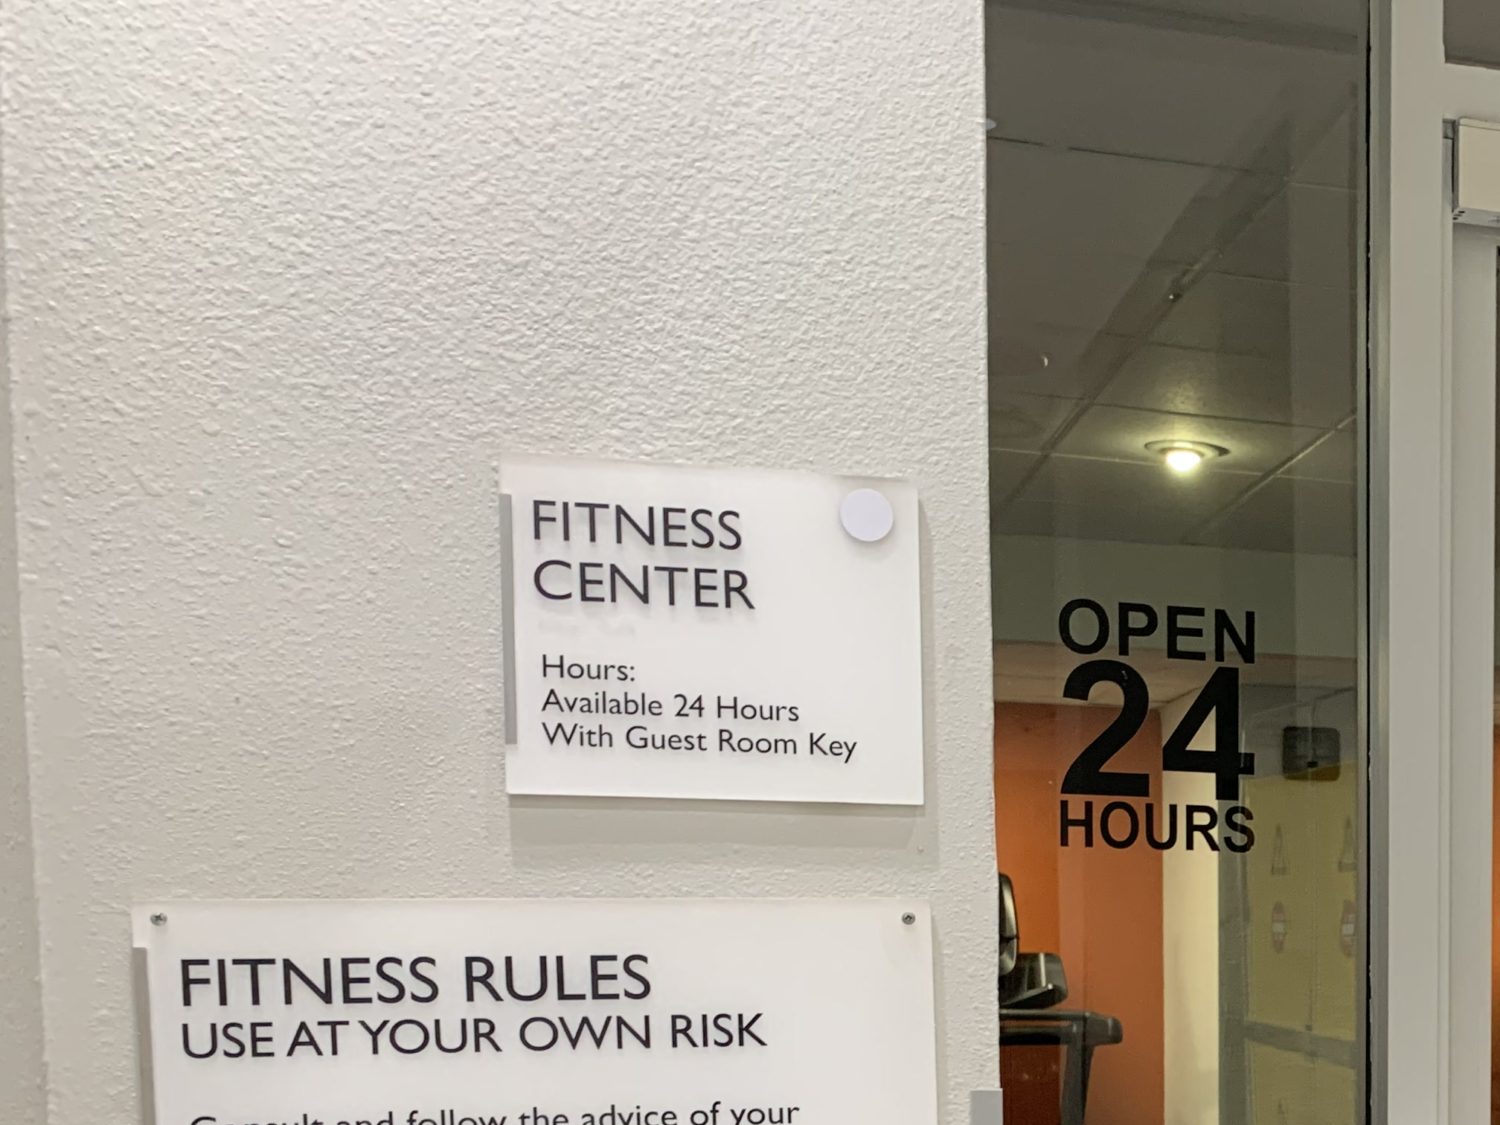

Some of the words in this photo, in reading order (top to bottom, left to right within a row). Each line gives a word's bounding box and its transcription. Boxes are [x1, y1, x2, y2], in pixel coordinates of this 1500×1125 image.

[533, 500, 742, 550] FITNESS
[534, 560, 755, 609] CENTER
[1058, 598, 1255, 664] OPEN
[543, 654, 635, 682] Hours:
[542, 689, 662, 716] Available
[674, 694, 705, 718] 24
[717, 696, 799, 722] Hours
[1061, 659, 1254, 800] 24
[542, 722, 613, 747] With
[626, 726, 707, 751] Guest
[719, 729, 797, 754] Room
[810, 732, 857, 763] Key
[1060, 800, 1254, 853] HOURS
[181, 957, 439, 1006] FITNESS
[465, 954, 651, 1002] RULES
[182, 1022, 275, 1059] USE
[287, 1021, 349, 1057] AT
[358, 1018, 502, 1055] YOUR
[519, 1015, 651, 1051] OWN
[671, 1013, 767, 1048] RISK
